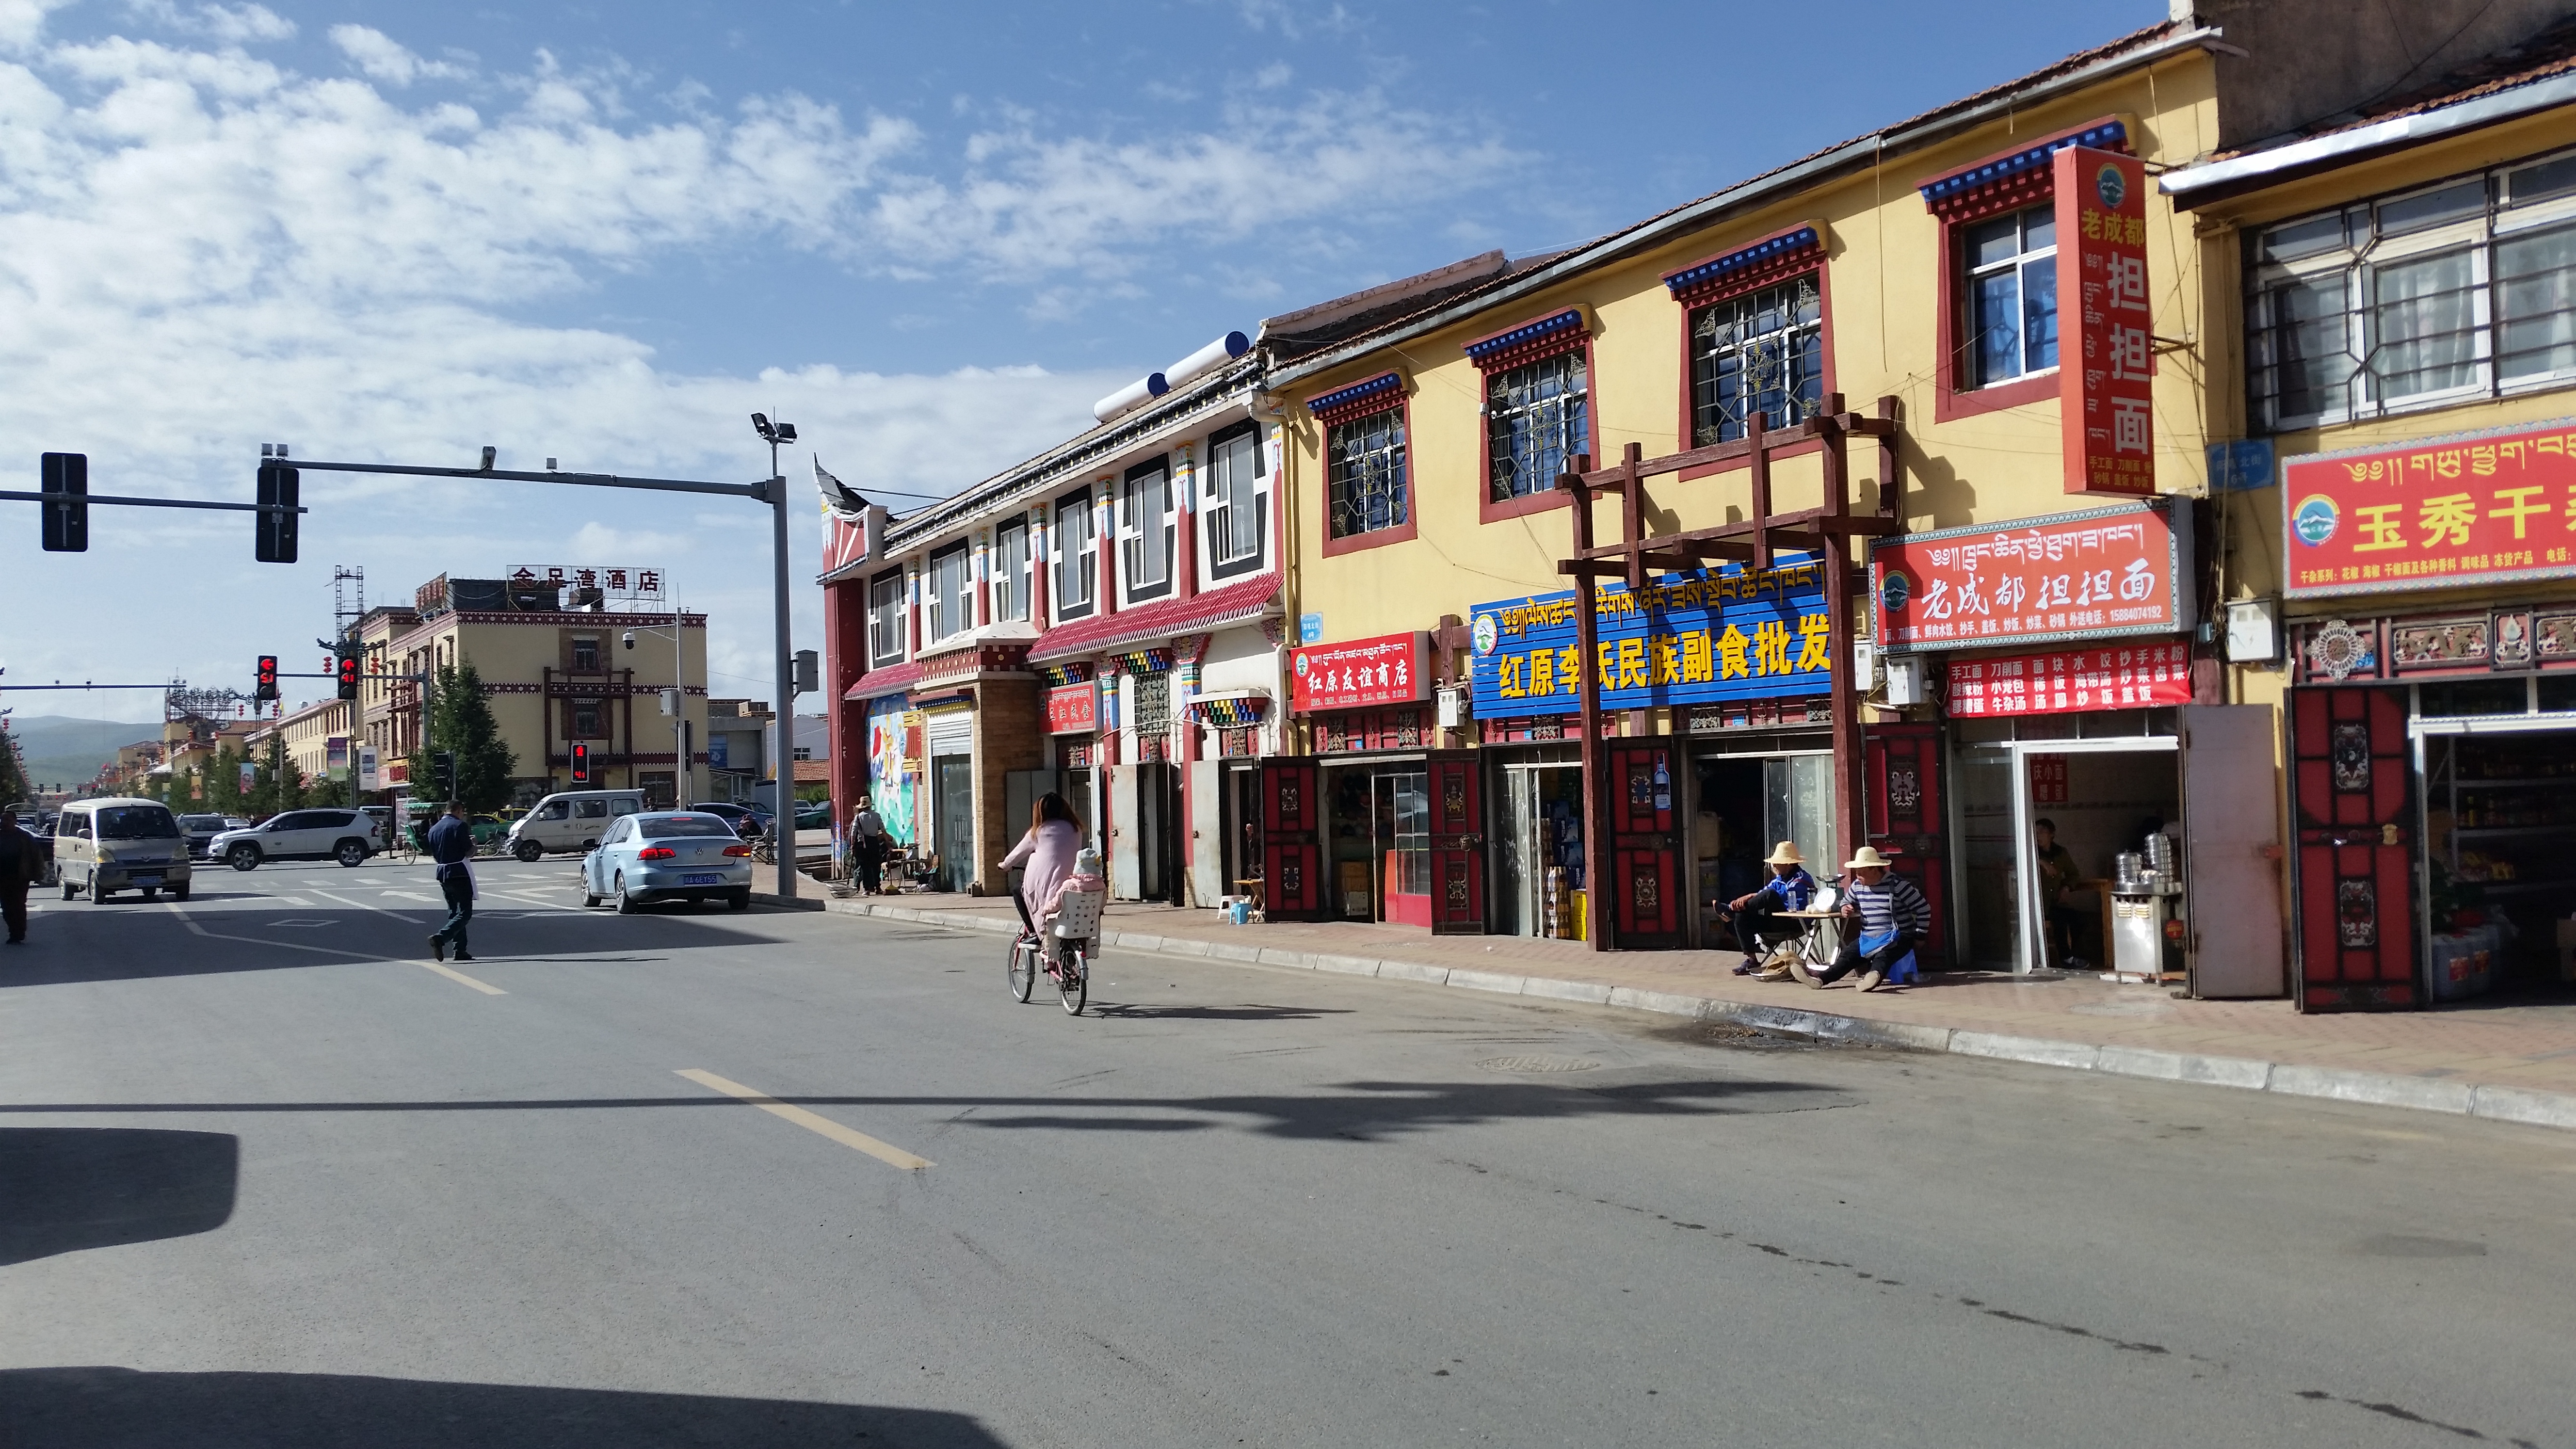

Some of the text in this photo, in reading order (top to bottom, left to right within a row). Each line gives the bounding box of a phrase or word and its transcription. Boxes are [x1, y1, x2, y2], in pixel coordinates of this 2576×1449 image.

[2082, 208, 2145, 248] 老成都
[2107, 251, 2151, 455] 担担面
[2342, 566, 2359, 580] 花椒
[2462, 554, 2489, 570] 调味品
[2495, 550, 2533, 567] 冻货产品
[1308, 659, 1408, 694] 红原友谊商店
[1951, 663, 1982, 679] 手工面
[1991, 661, 2023, 677] 刀削面
[1952, 681, 1983, 697] 酸辣粉
[1991, 678, 2025, 695] 小笼包
[2075, 671, 2112, 689] 海带汤
[1992, 695, 2027, 712] 牛杂汤
